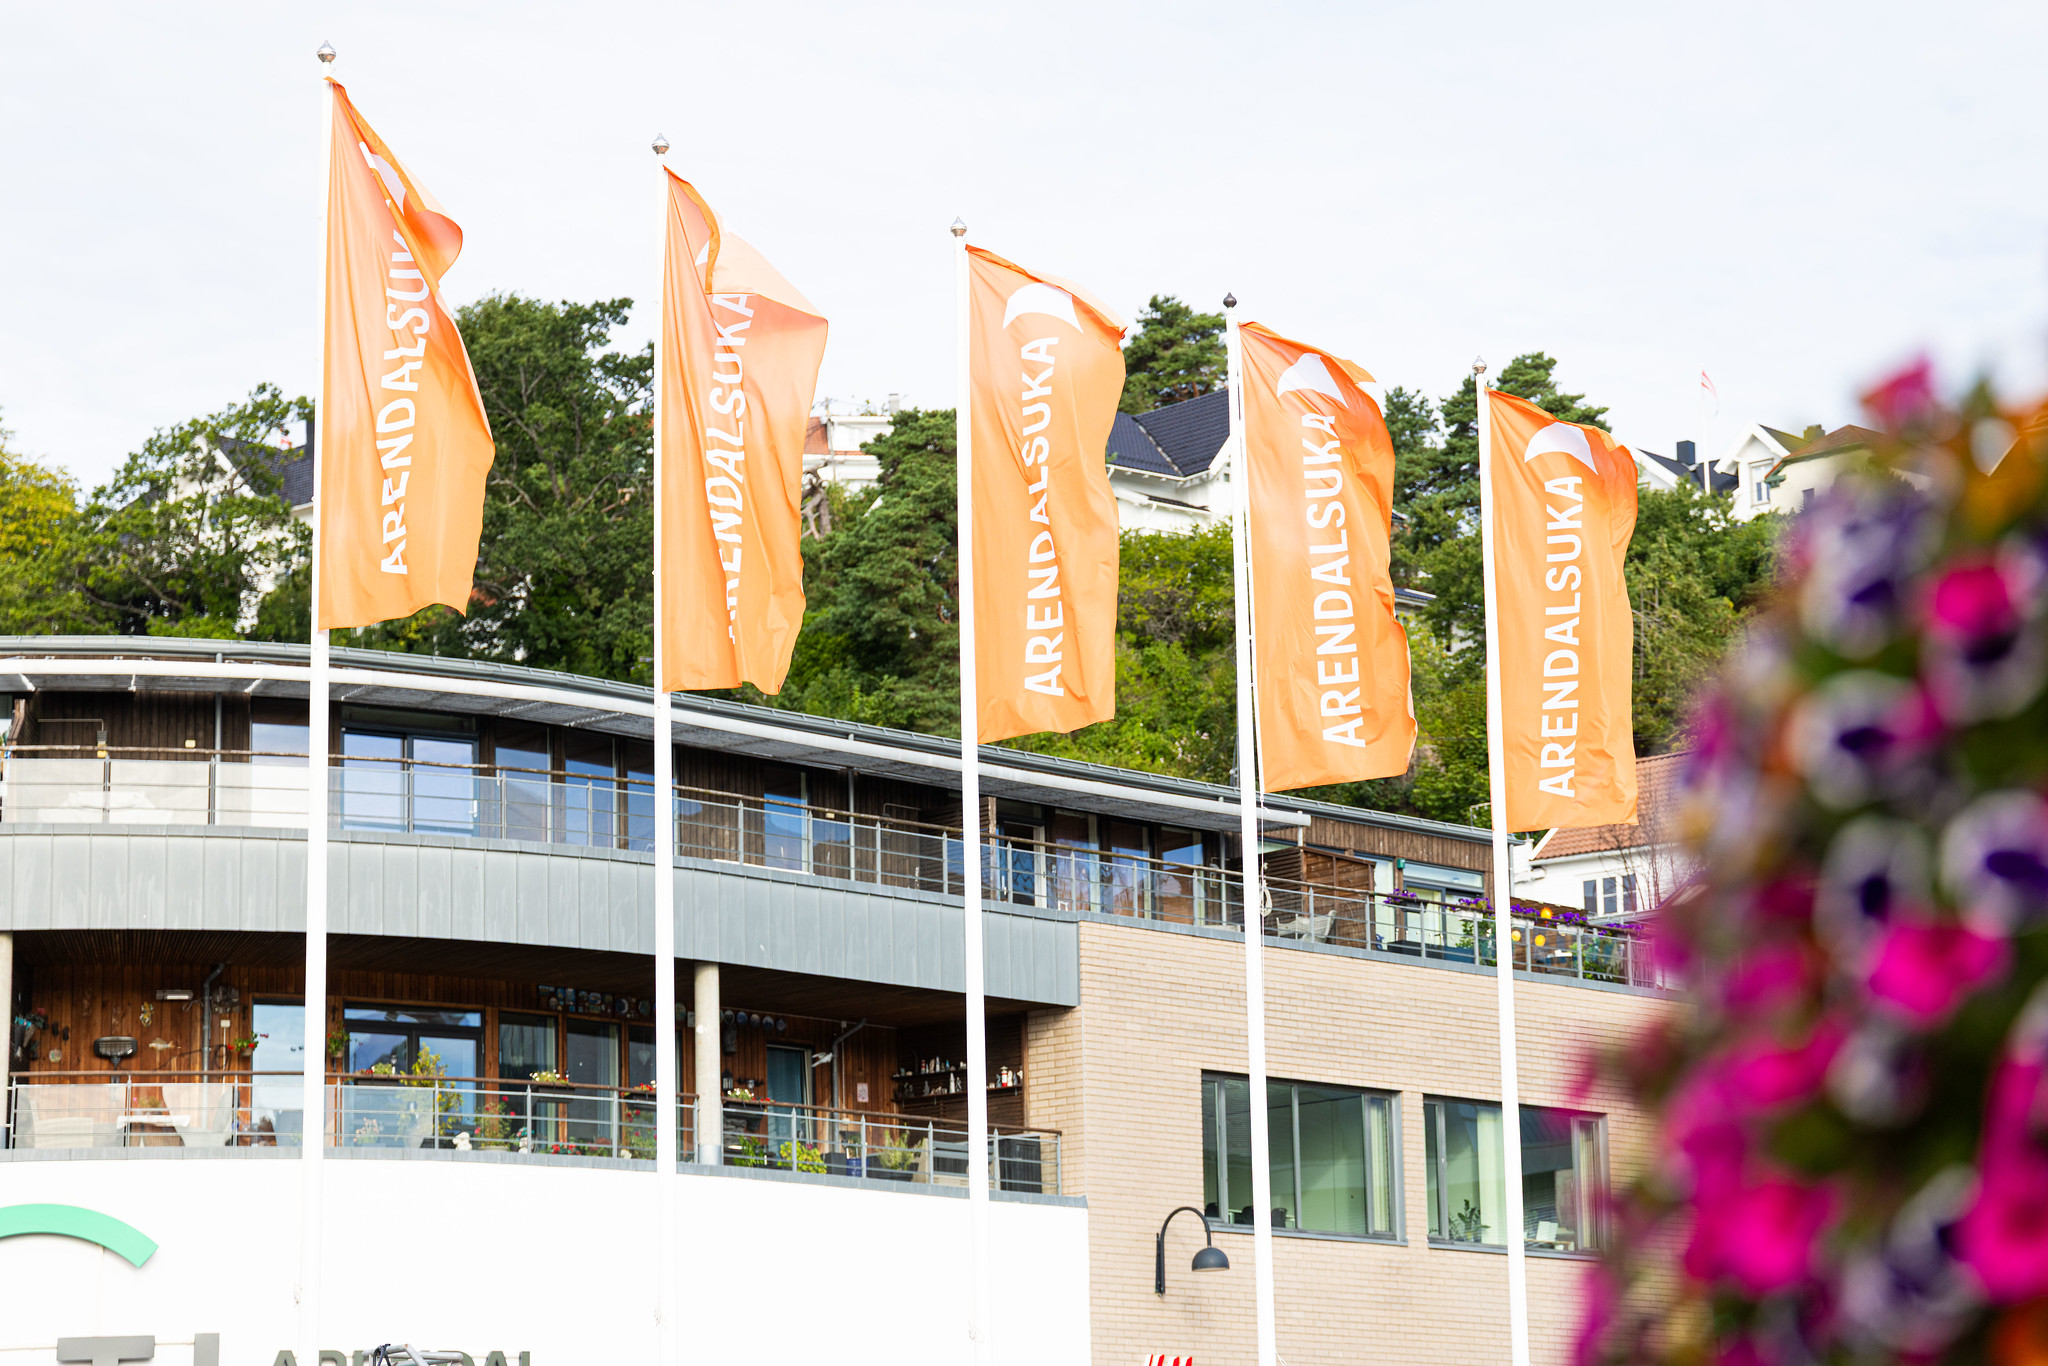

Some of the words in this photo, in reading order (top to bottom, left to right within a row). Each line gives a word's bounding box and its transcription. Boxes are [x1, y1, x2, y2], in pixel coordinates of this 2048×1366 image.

[1021, 336, 1064, 697] ARENDALSUKA
[1301, 412, 1366, 748] ARENDALSUKA
[1538, 475, 1583, 798] ARENDALSUKA
